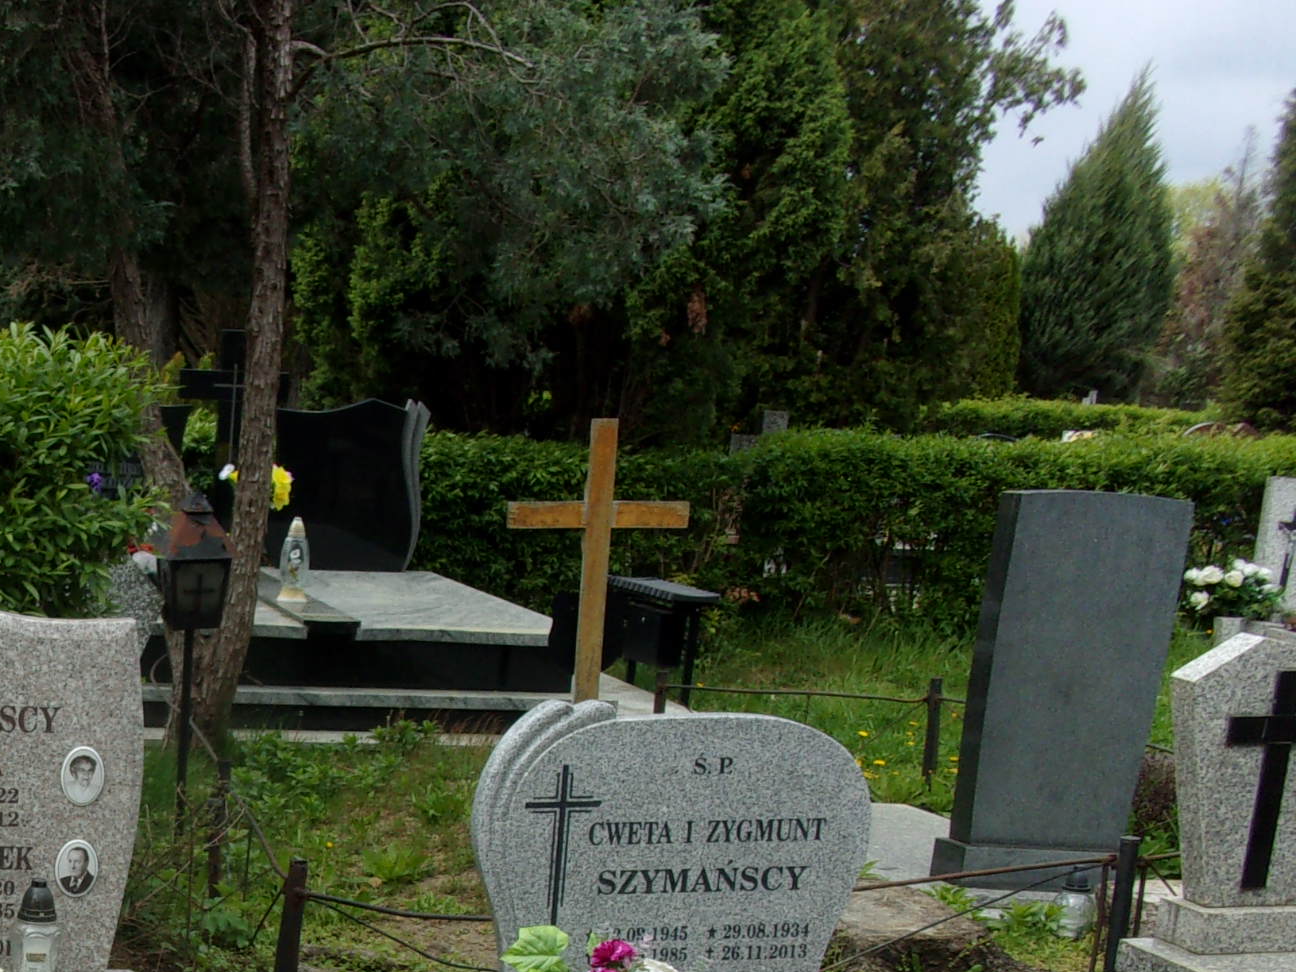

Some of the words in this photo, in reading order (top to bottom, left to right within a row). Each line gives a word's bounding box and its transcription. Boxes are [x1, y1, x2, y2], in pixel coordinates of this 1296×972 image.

[684, 819, 694, 844] I
[706, 816, 827, 844] ZYGMUNT
[597, 859, 811, 896] SZYMAŃSCY
